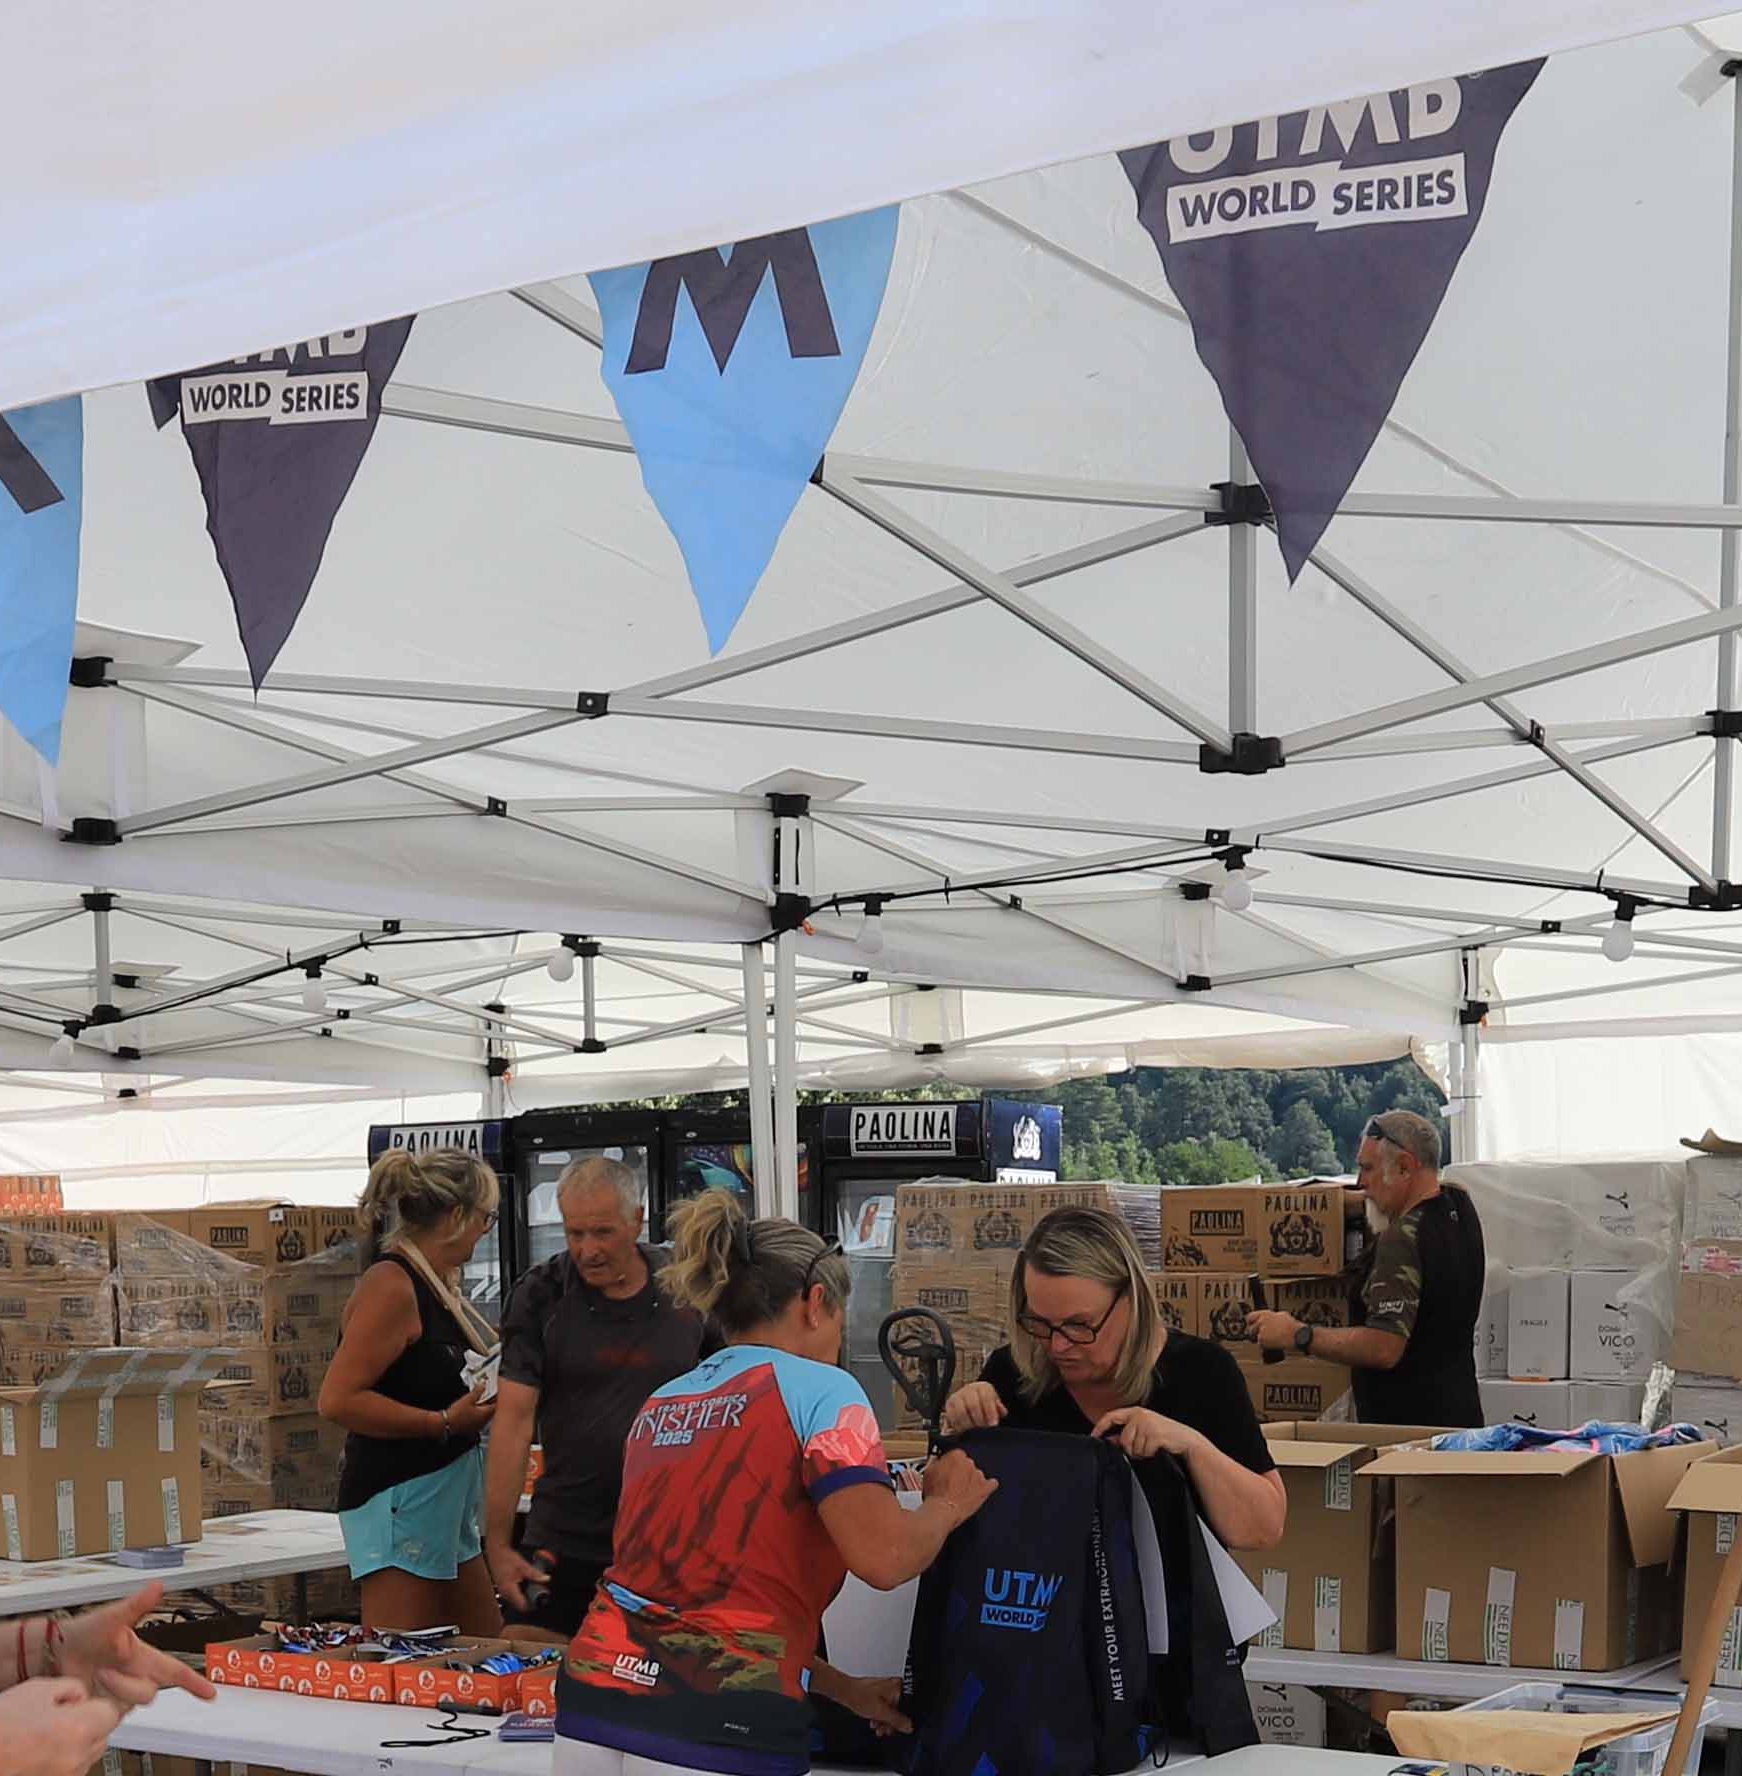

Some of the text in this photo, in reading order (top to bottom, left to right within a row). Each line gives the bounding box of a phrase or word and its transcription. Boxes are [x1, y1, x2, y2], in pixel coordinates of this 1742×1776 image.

[1179, 169, 1457, 227] WORLD SERIES
[189, 379, 361, 414] WORLD SERIES
[854, 1110, 952, 1141] PAOLINA
[971, 1192, 1026, 1208] PAOLINA
[1265, 1195, 1329, 1213] PAOLINA
[1192, 1211, 1243, 1231] PAOLINA
[1599, 1335, 1636, 1348] VICO
[1266, 1386, 1320, 1406] PAOLINA
[653, 1430, 694, 1447] 2025
[984, 1567, 1063, 1606] UTM
[985, 1608, 1035, 1626] WORLD
[1105, 1625, 1120, 1666] YOUR
[616, 1653, 660, 1676] UTMB
[1110, 1667, 1126, 1701] MEET
[1258, 1705, 1295, 1714] DOMAINE
[1258, 1714, 1296, 1729] VICO
